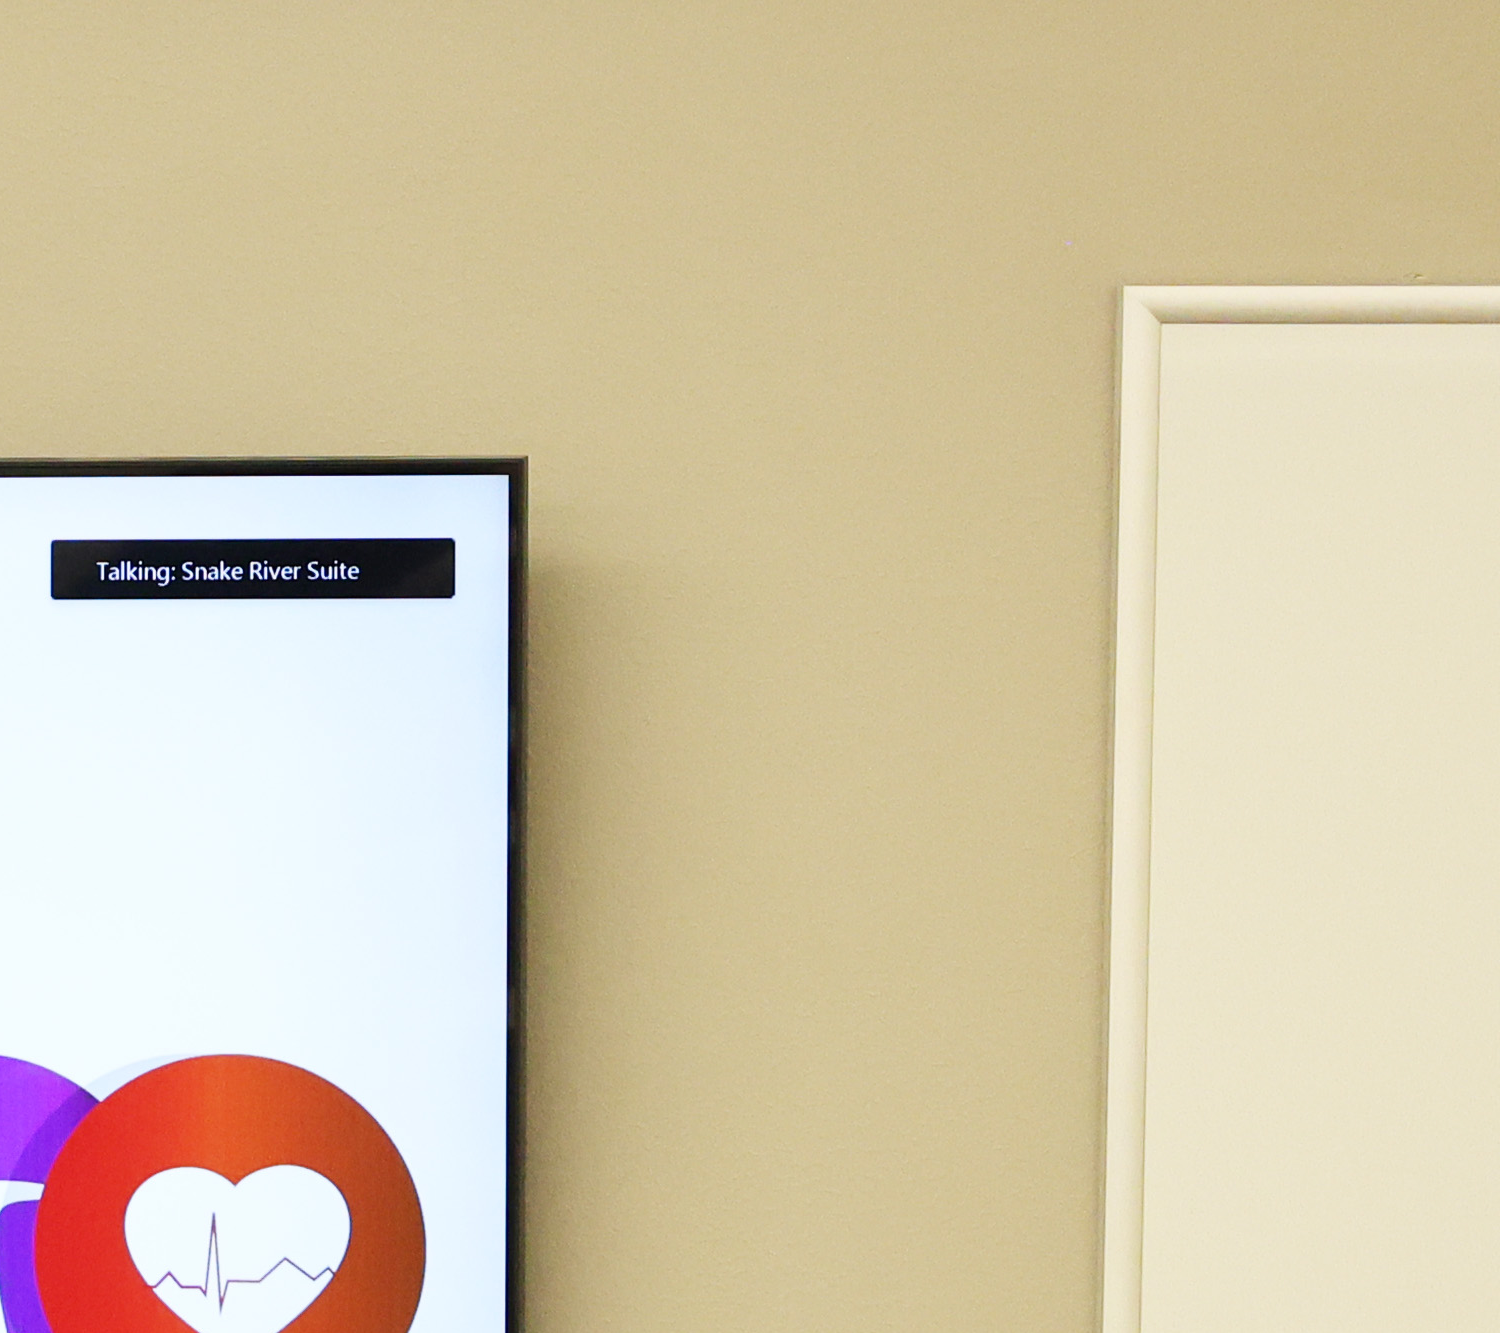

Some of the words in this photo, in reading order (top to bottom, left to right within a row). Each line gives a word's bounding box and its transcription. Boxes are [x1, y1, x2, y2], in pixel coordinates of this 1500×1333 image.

[96, 561, 175, 586] Talking:
[182, 561, 243, 580] Snake
[250, 561, 301, 580] River
[308, 560, 359, 579] Suite
